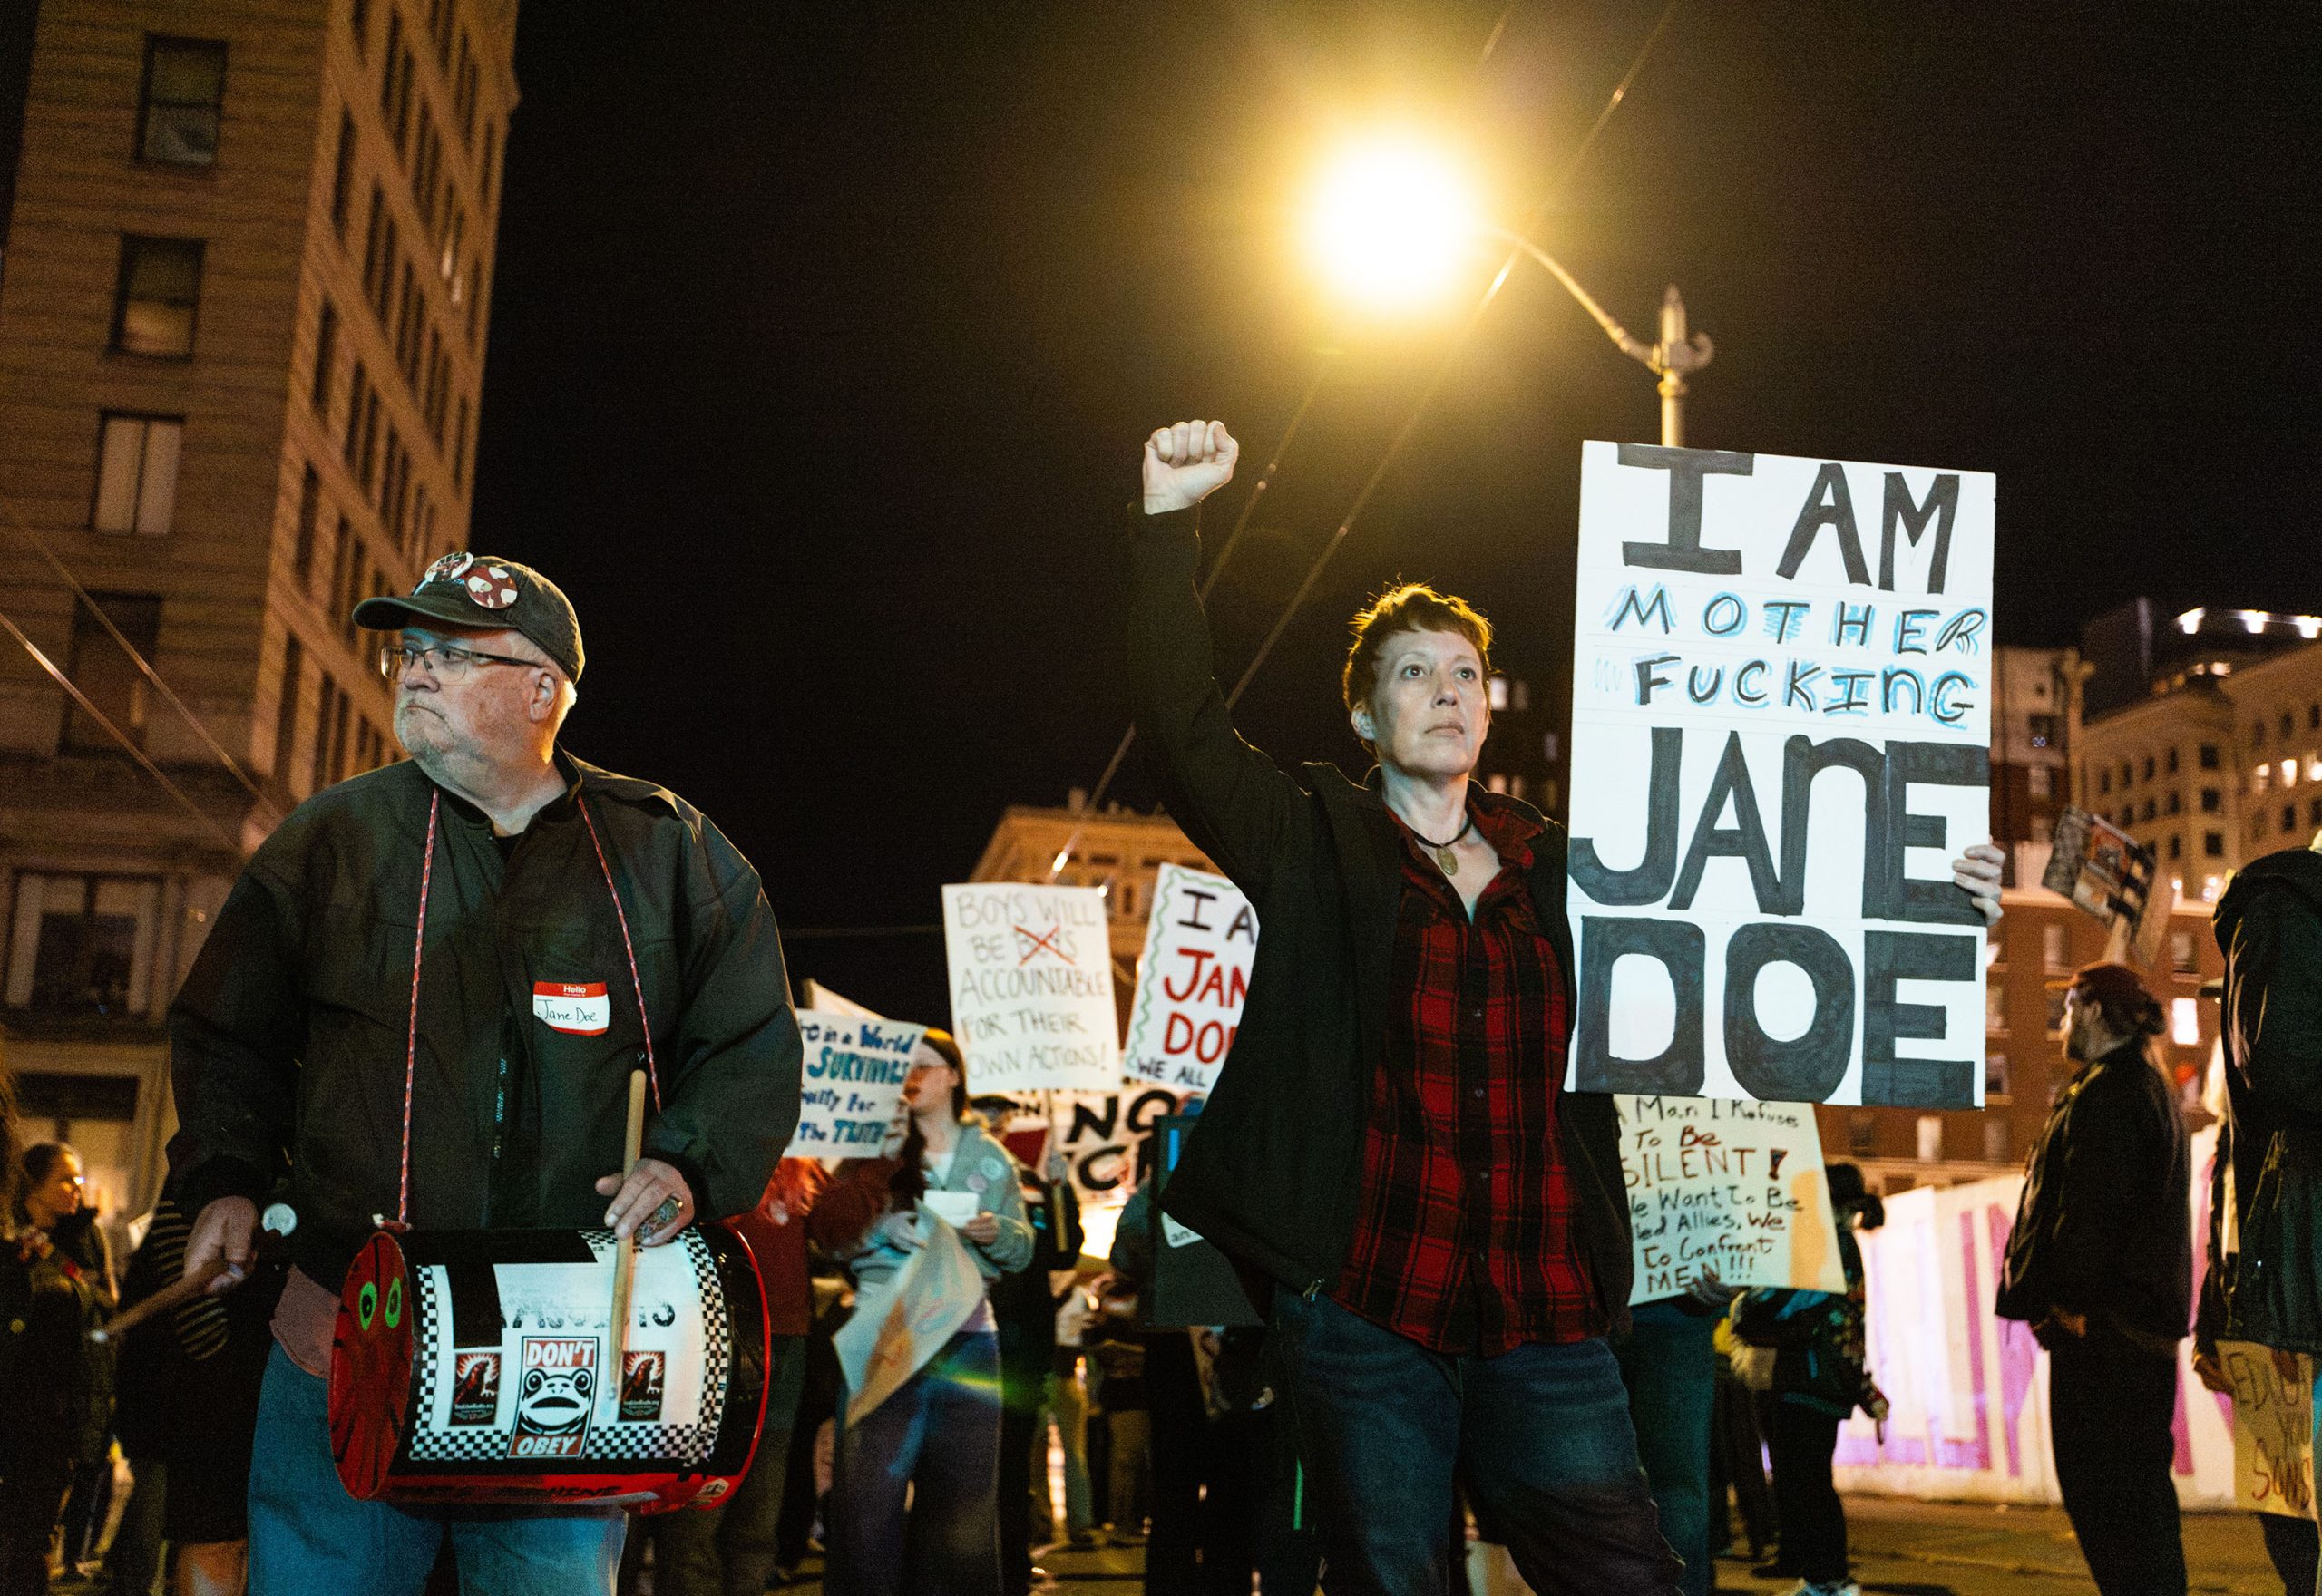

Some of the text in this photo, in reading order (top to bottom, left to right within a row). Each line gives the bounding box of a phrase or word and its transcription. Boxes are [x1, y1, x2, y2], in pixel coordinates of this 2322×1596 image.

[1617, 442, 1960, 595] I AM
[1608, 583, 1988, 655] MOTHER
[1634, 652, 1978, 729] FUCKING
[954, 891, 1098, 929] BOYS WILL
[1177, 889, 1256, 945] I A
[968, 934, 1007, 964] BE
[563, 985, 586, 994] Hello
[958, 966, 1109, 1009] ACCOUNTABLE
[1164, 946, 1247, 1009] JAN
[536, 998, 598, 1024] Jane Doe
[960, 1008, 1088, 1045] FOR THEIR
[1576, 915, 1985, 1111] DOE
[860, 1023, 916, 1054] World
[966, 1046, 1022, 1079] OWN
[1137, 1056, 1206, 1087] WE ALL
[1680, 1125, 1722, 1147] Be
[1658, 1187, 1722, 1212] Want
[1767, 1187, 1805, 1212] Be
[1747, 1212, 1786, 1231] We
[526, 1339, 595, 1367] DON'T
[517, 1435, 578, 1457] OBEY
